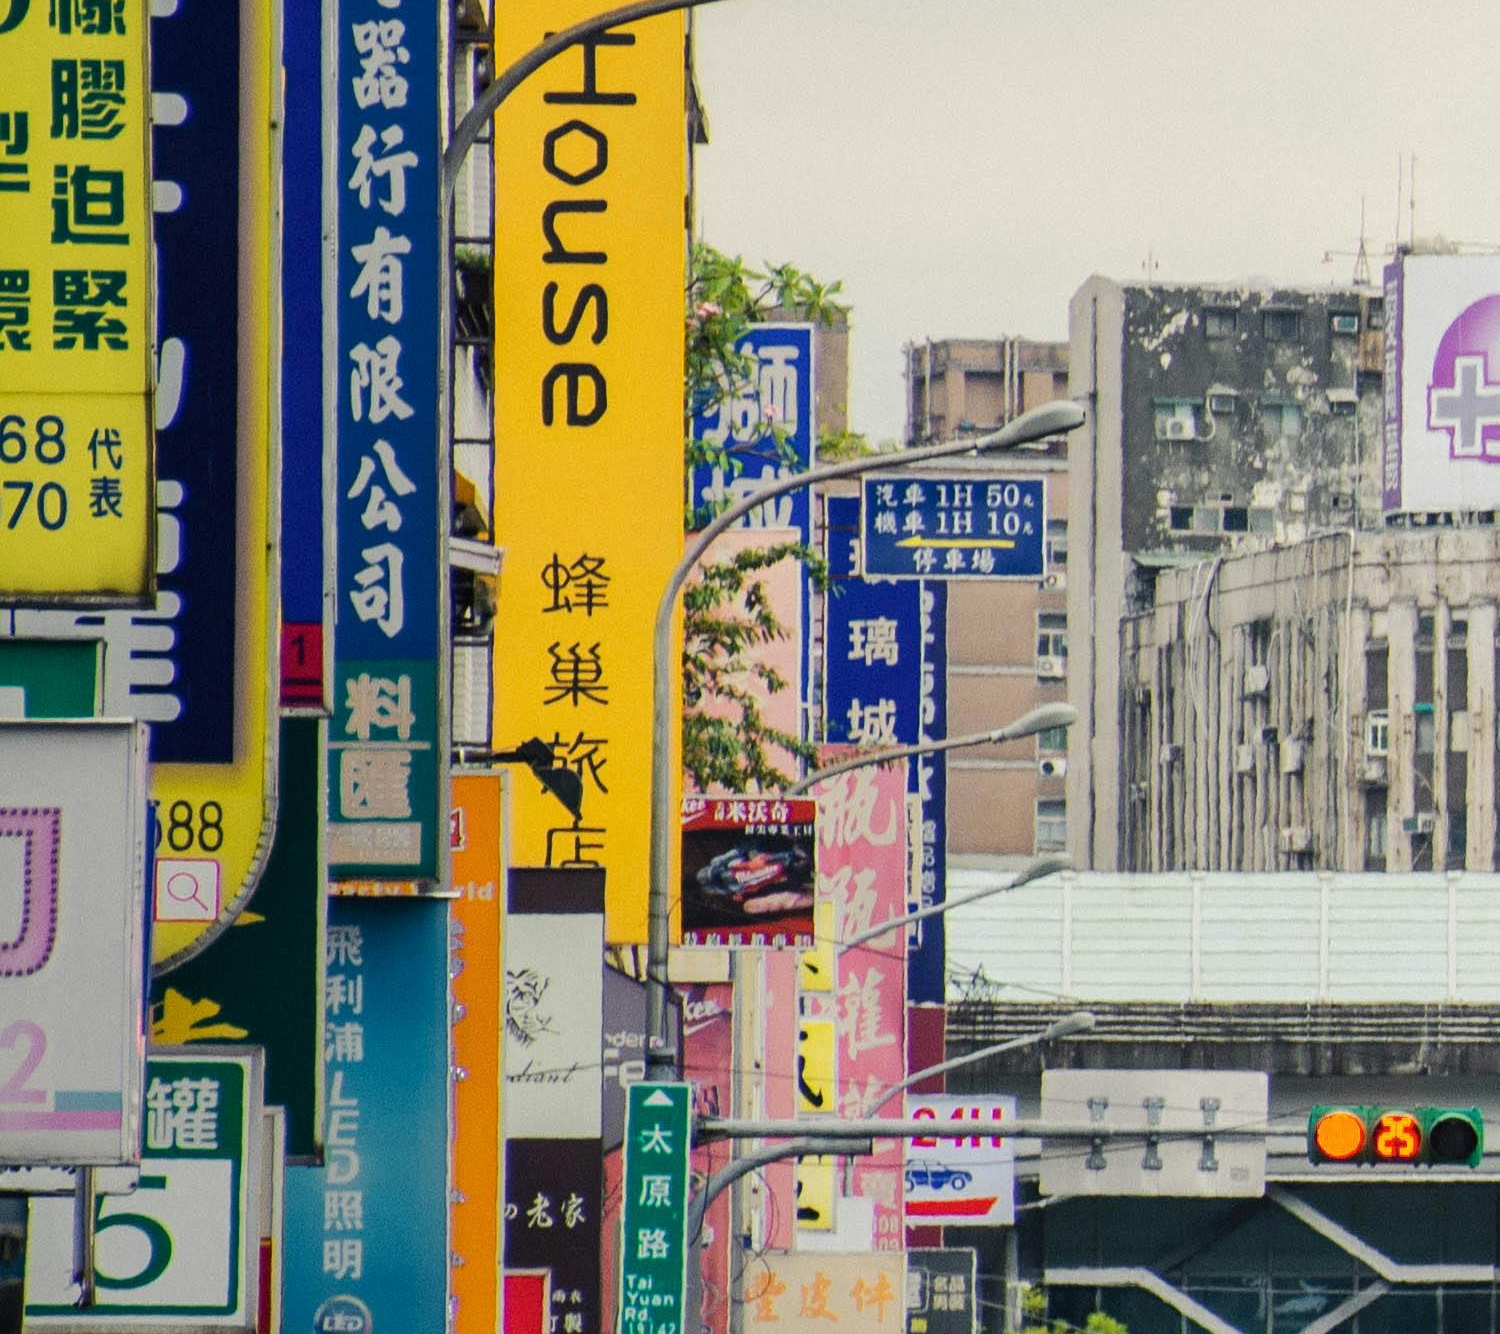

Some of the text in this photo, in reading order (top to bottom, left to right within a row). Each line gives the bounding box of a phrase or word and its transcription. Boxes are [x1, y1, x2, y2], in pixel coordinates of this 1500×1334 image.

[542, 29, 638, 428] House
[87, 426, 124, 520] 代表
[637, 1123, 674, 1260] 太原路
[626, 1274, 654, 1290] Tai
[626, 1291, 675, 1307] Yuan
